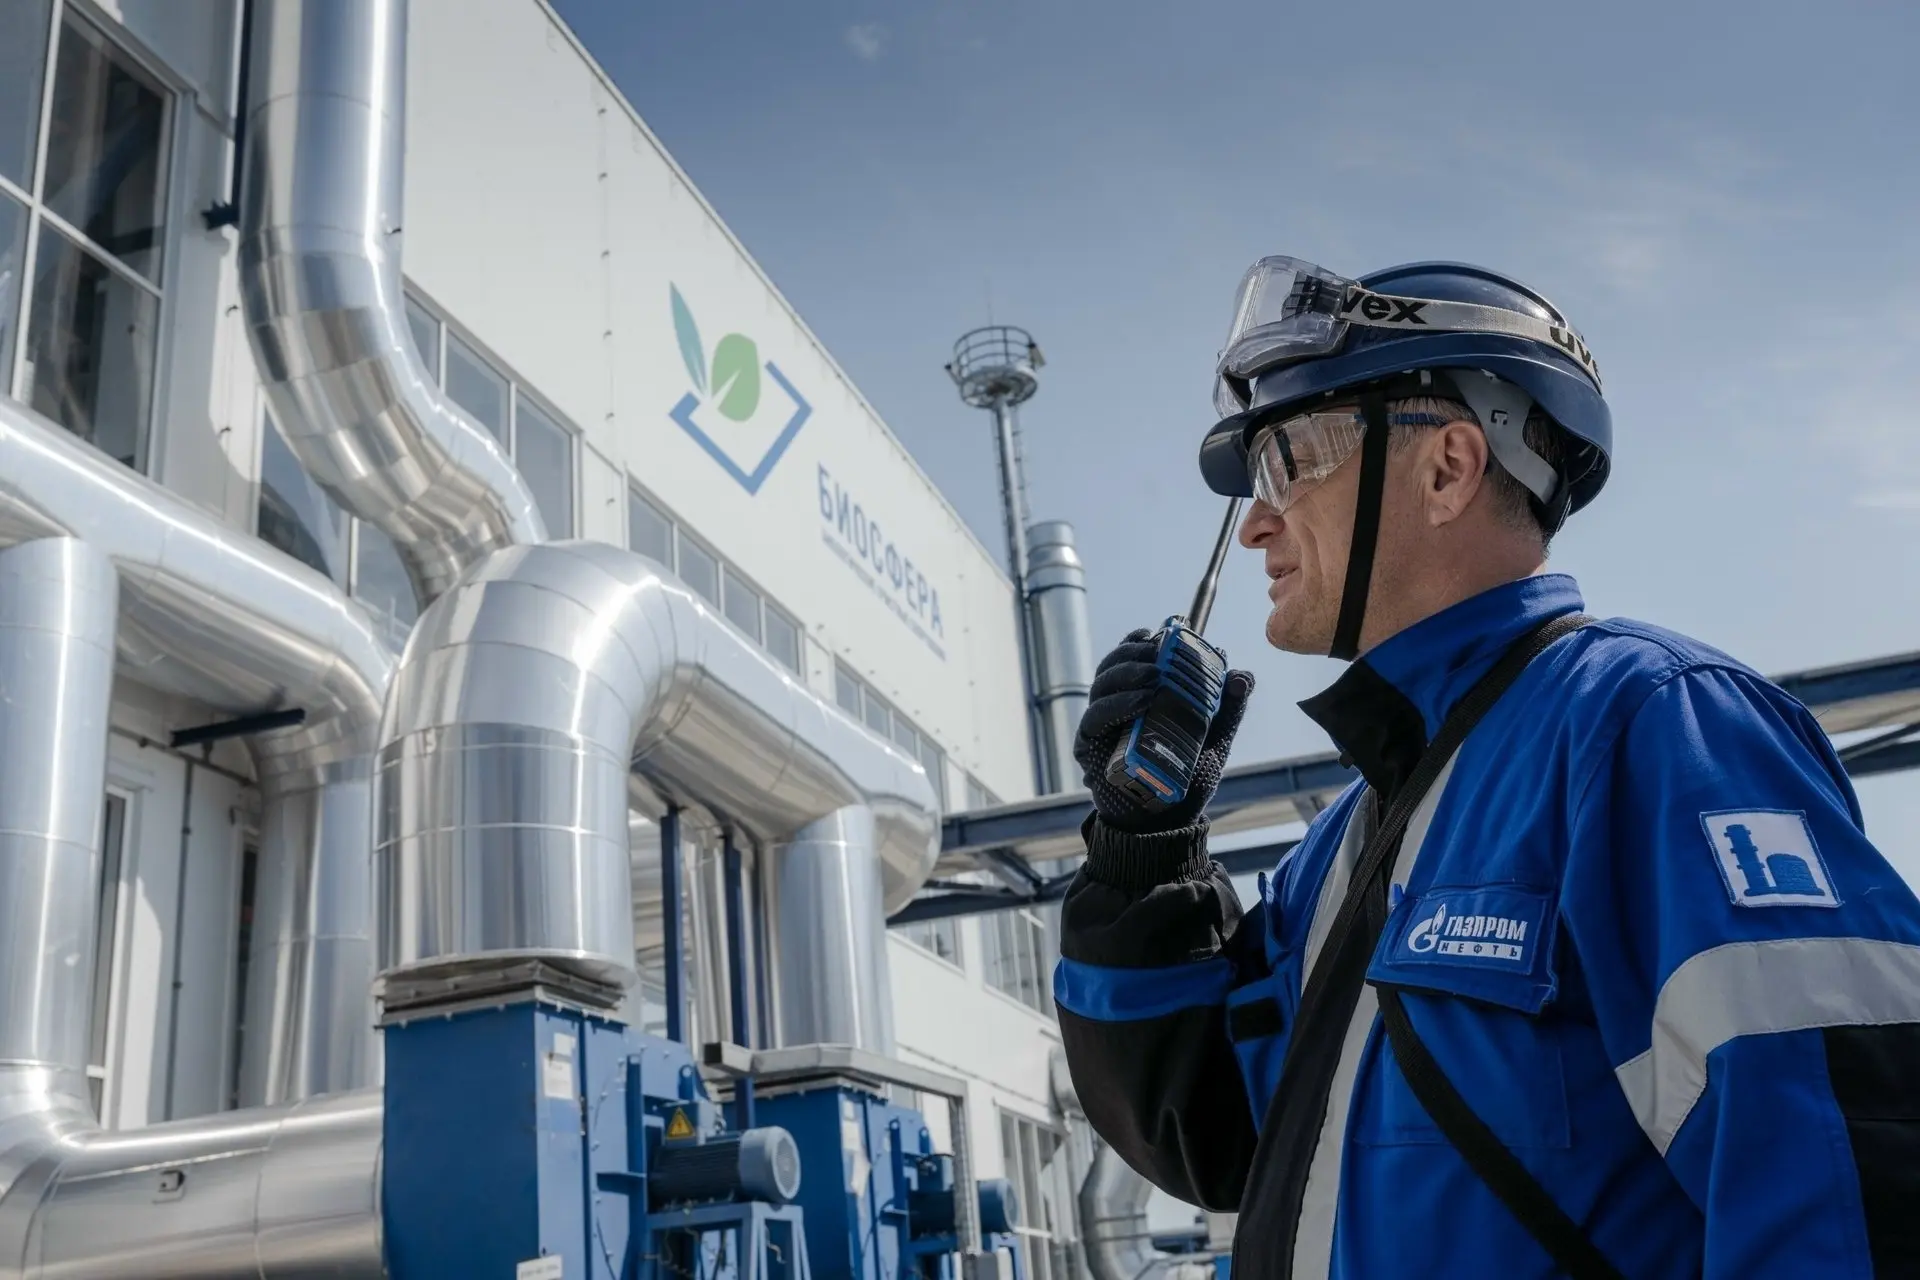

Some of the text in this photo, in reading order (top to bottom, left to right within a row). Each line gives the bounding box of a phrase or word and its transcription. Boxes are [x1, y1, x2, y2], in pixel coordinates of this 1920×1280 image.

[1341, 290, 1429, 325] vex
[818, 461, 944, 639] БИОСФЕРА
[1443, 915, 1529, 941] ГАЗПРОМ
[1440, 942, 1519, 958] НЕФТЬ
